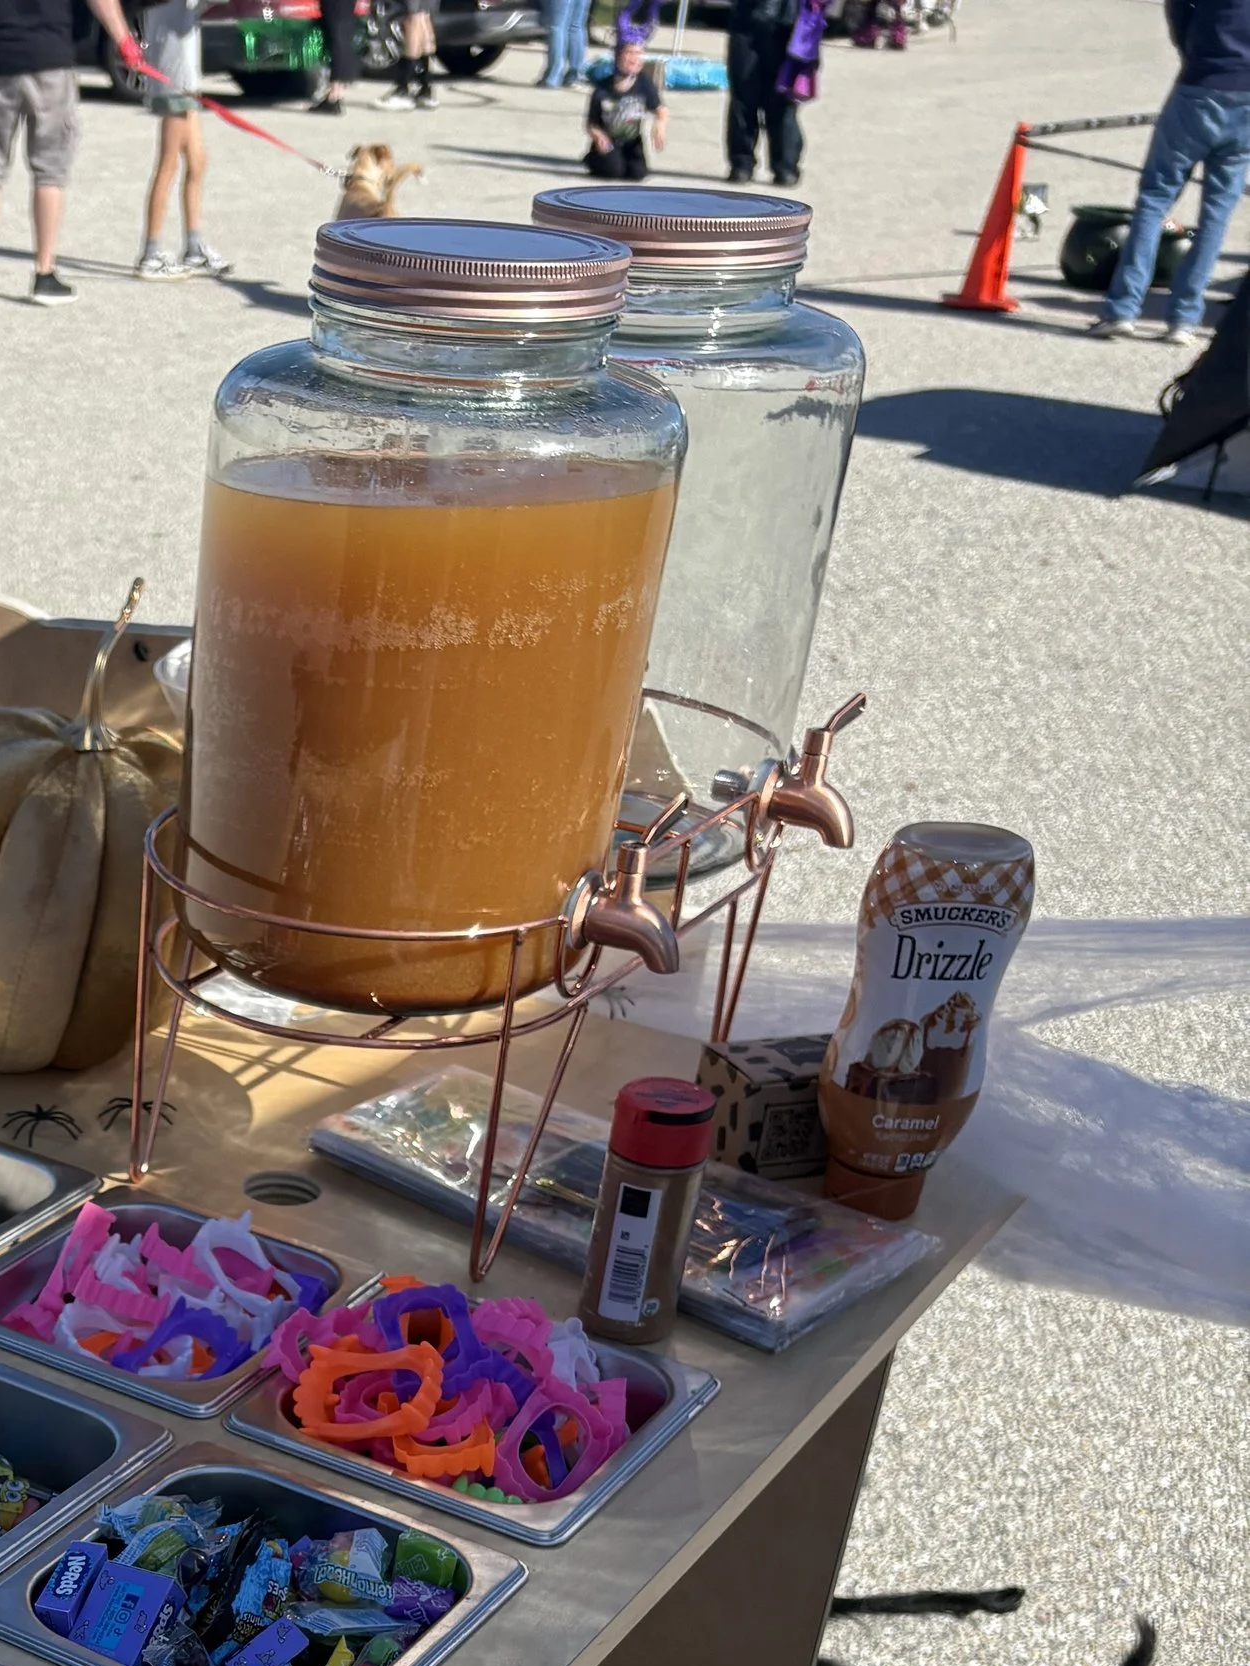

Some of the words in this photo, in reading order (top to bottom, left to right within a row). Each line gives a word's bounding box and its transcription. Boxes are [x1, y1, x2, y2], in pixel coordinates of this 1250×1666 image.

[900, 906, 1012, 929] SMUCKER'S
[890, 934, 993, 982] Drizzle
[871, 1113, 940, 1131] Caramel
